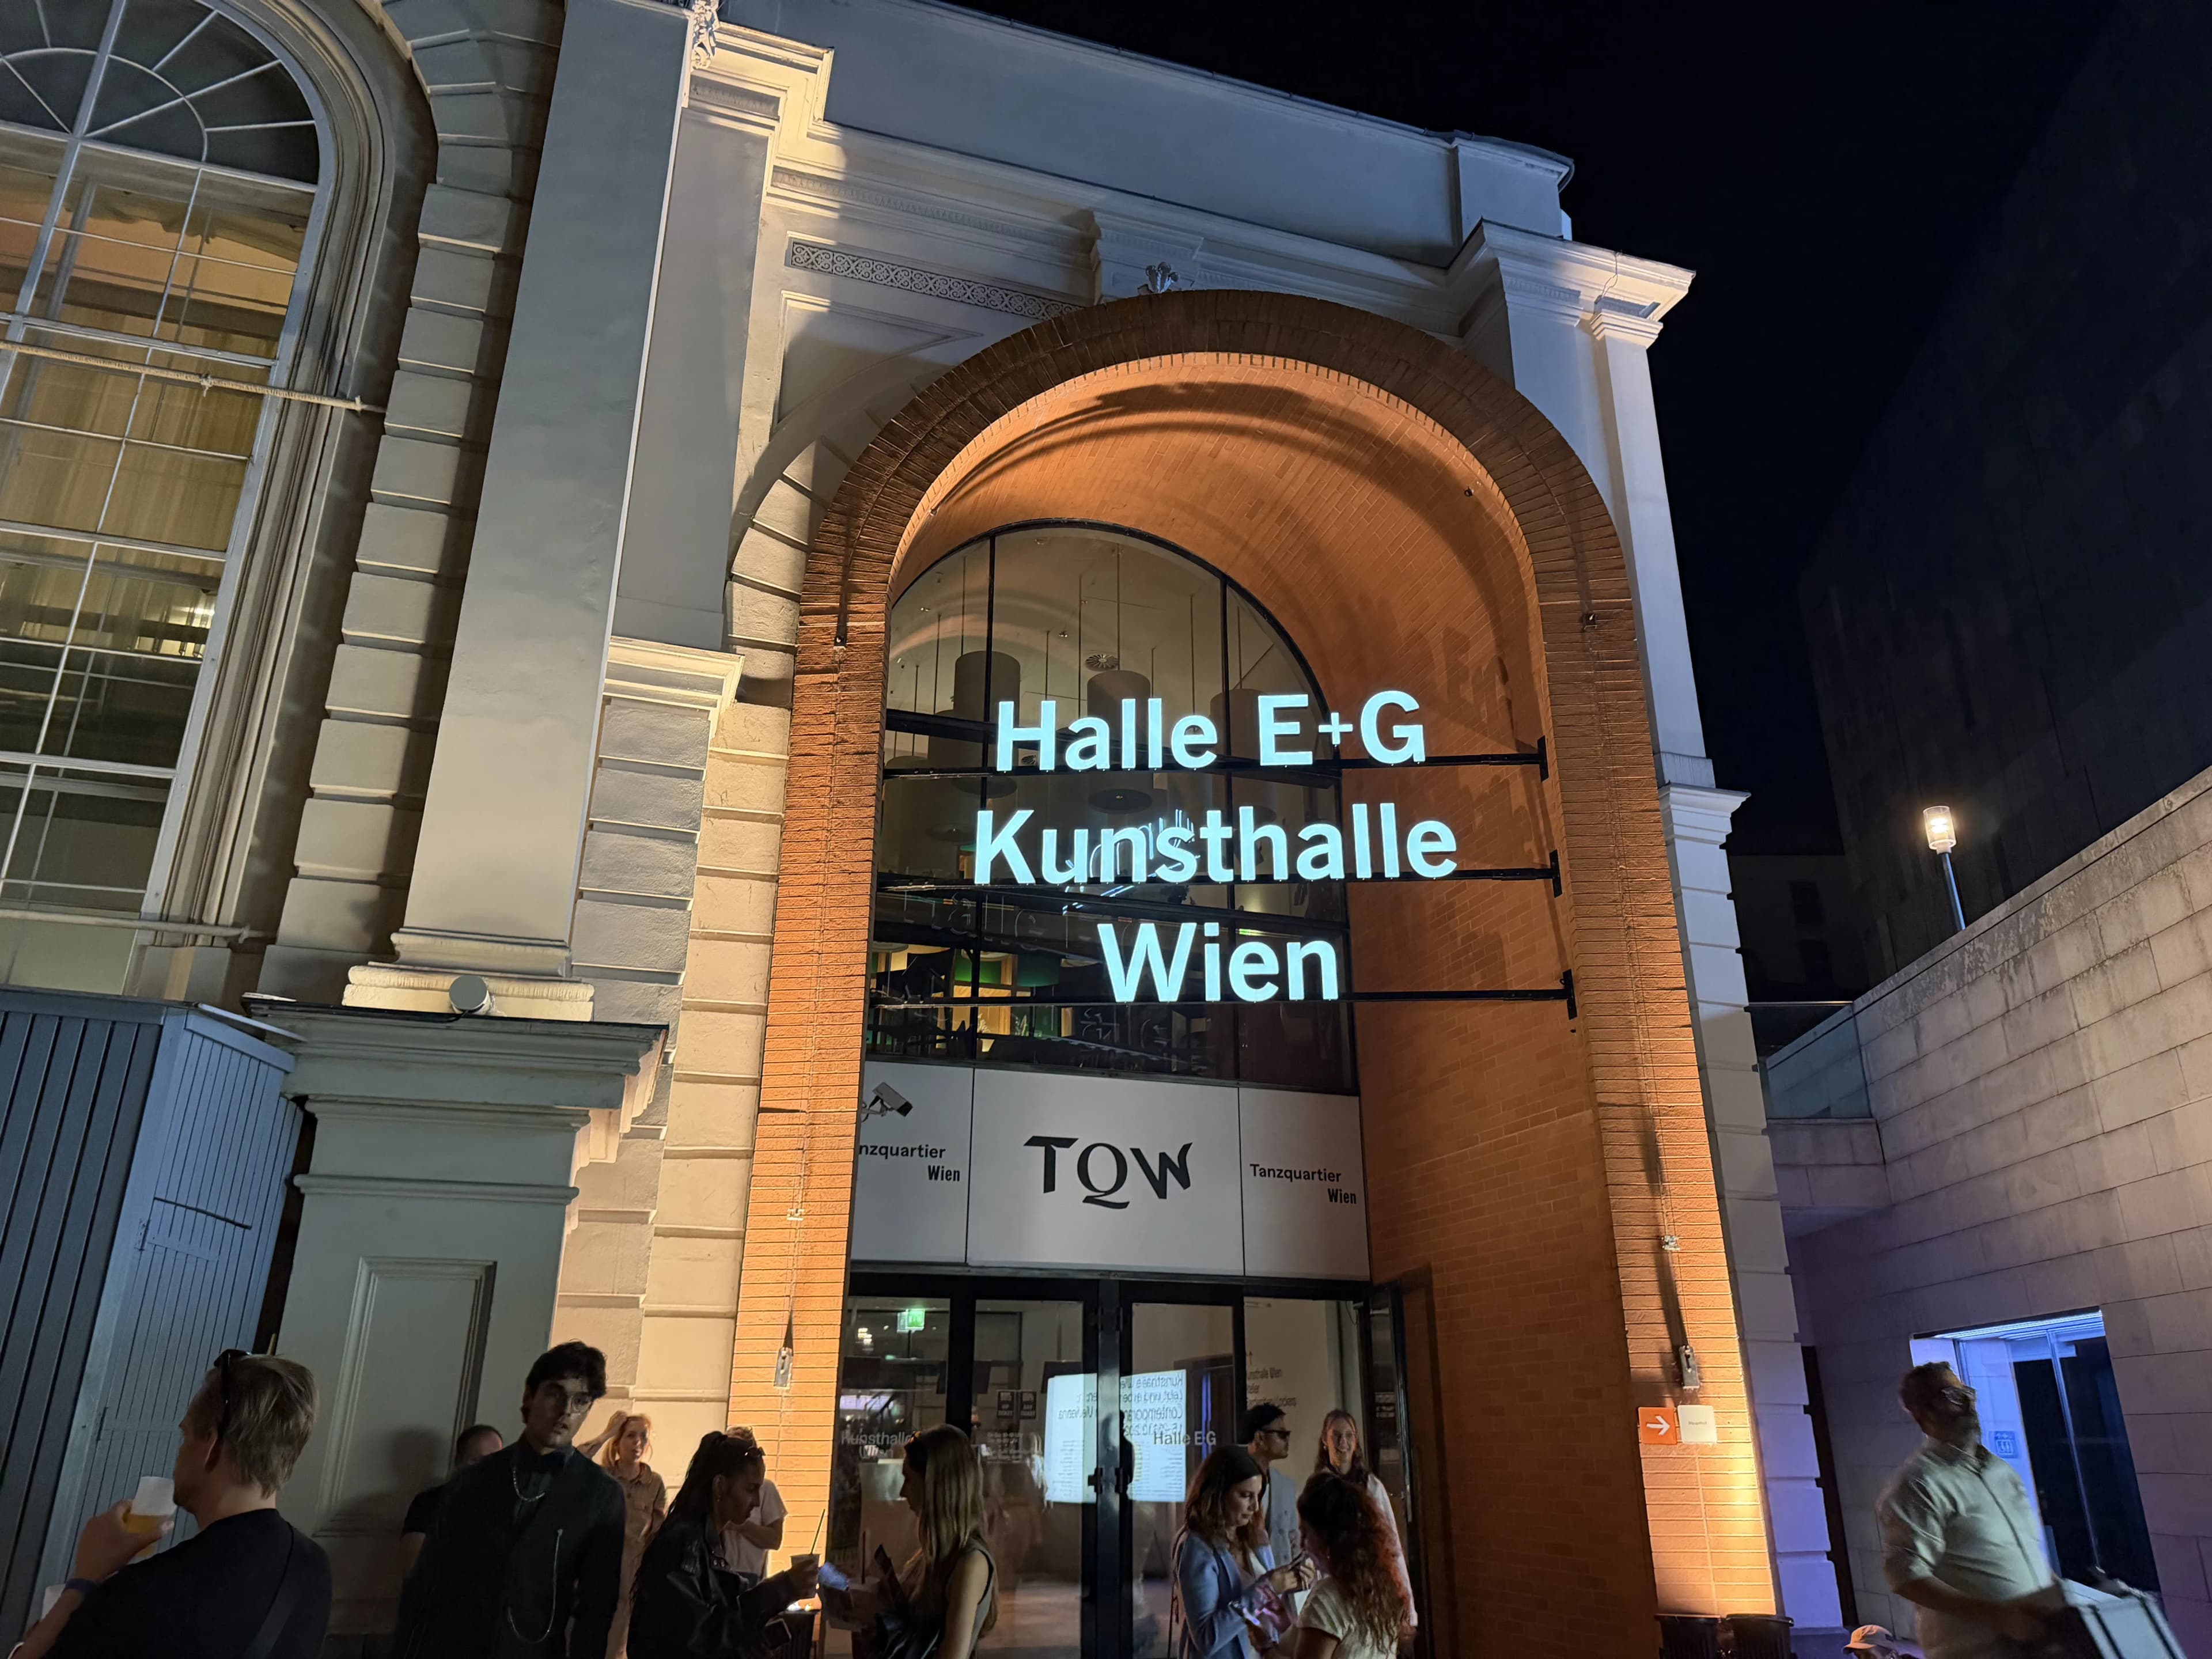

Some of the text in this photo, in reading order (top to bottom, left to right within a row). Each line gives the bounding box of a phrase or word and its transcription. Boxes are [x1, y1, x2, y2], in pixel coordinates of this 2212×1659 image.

[997, 691, 1425, 772] Halle E+G
[975, 803, 1457, 885] Kunsthalle
[1097, 923, 1338, 1003] Wien
[859, 1144, 946, 1160] nzquartier
[927, 1165, 960, 1181] Wien
[1024, 1136, 1192, 1209] TQW
[1249, 1164, 1342, 1183] Tanzquartier
[1328, 1188, 1357, 1205] Wien
[1154, 1431, 1191, 1445] Halle
